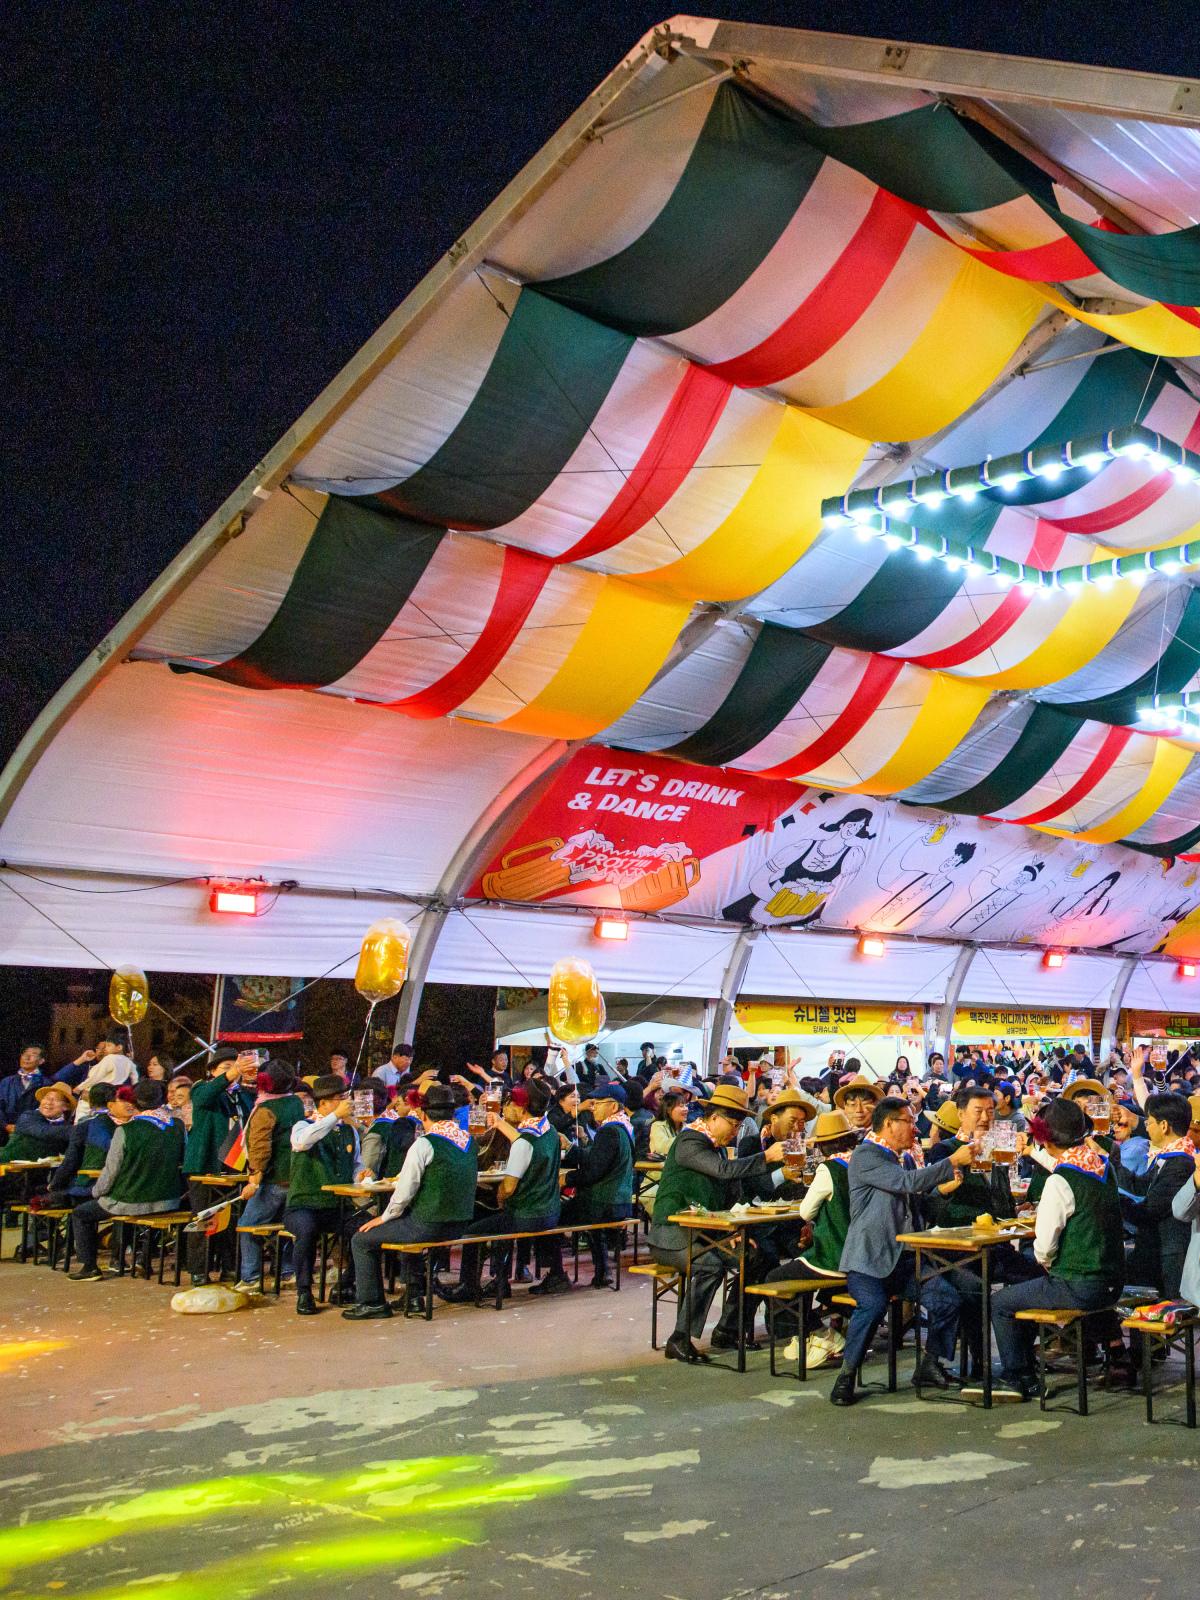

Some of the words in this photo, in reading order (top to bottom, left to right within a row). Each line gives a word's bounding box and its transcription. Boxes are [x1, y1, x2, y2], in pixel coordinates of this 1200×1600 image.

[660, 778, 746, 807] DRINK
[567, 791, 593, 811] &
[596, 793, 691, 822] DANCE
[794, 1005, 830, 1023] 슈니첼
[834, 1006, 857, 1024] 맛집
[970, 1011, 999, 1024] 맥주안주
[1000, 1013, 1029, 1025] 어디까지
